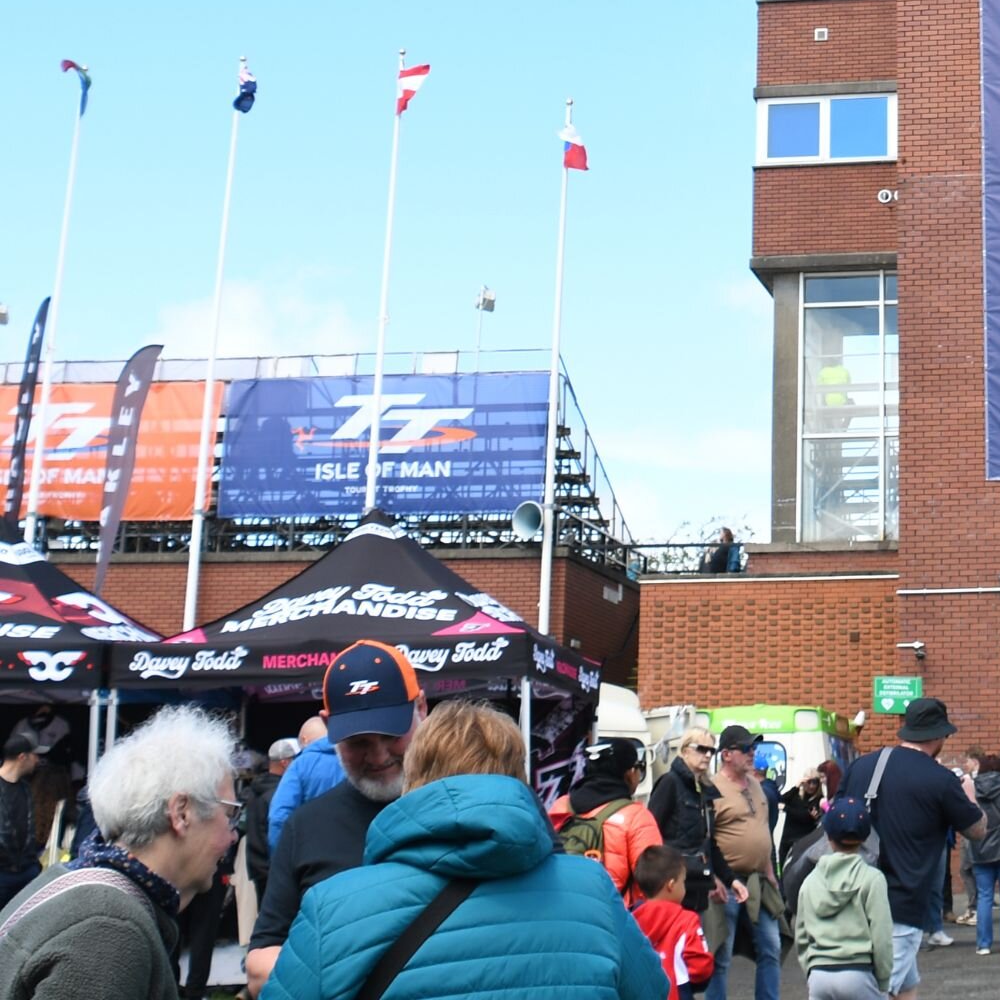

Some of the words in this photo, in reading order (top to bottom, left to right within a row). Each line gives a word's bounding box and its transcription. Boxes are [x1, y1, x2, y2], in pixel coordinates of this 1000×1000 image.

[334, 393, 475, 454] TT
[315, 462, 361, 481] ISLE
[400, 460, 451, 478] MAN
[220, 600, 458, 633] MERCHANDISE
[252, 586, 351, 621] Davey
[352, 584, 448, 607] Todd
[129, 651, 189, 679] Davey
[191, 646, 248, 671] Todd
[451, 637, 509, 662] Todd
[349, 680, 378, 695] TT
